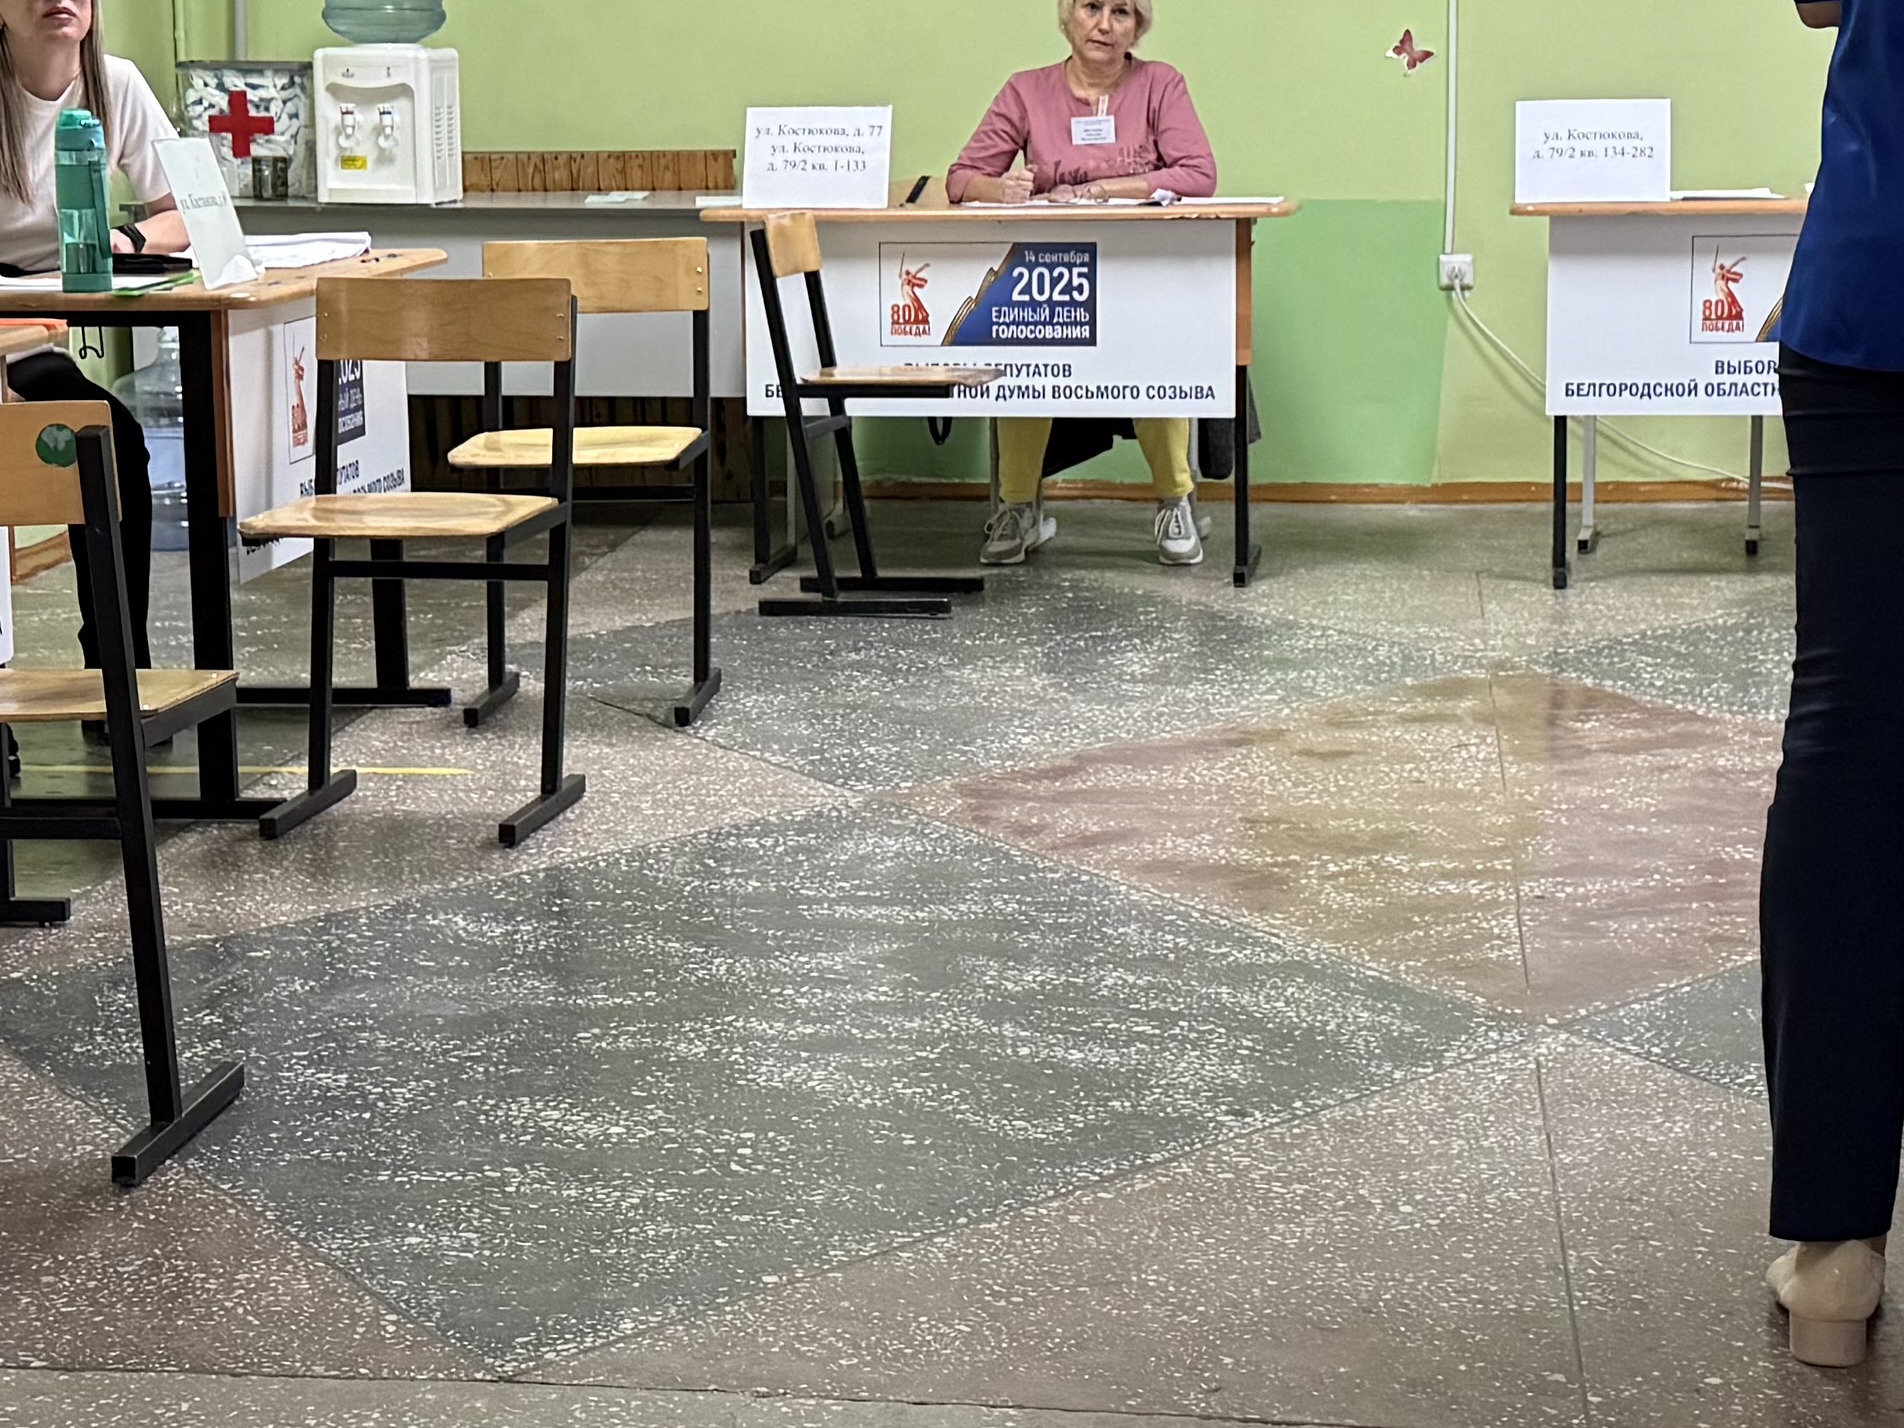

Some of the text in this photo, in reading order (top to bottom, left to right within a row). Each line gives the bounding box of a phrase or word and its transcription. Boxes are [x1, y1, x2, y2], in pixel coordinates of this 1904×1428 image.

[755, 124, 884, 139] ул. Костюкова, д. 77
[1543, 128, 1644, 144] ул. Костюкова,
[771, 142, 865, 157] ул. Костюкова,
[1532, 146, 1655, 160] д. 79/2 кв. 134-282
[767, 159, 867, 172] д. 79/2 кв. 1-133
[1024, 250, 1090, 264] 14 сентября
[1011, 266, 1090, 302] 2025
[991, 305, 1090, 324] ЕДИНЫЙ ДЕНЬ
[1701, 299, 1726, 318] 80
[890, 324, 931, 337] ПОБЕДА!
[1701, 321, 1745, 333] ПОБЕДА!
[995, 384, 1047, 402] ДУМЫ
[1051, 384, 1141, 400] ВОСЬМОГО
[1145, 384, 1216, 400] СОЗЫВА
[1565, 379, 1698, 400] БЕЛГОРОДСКОЙ
